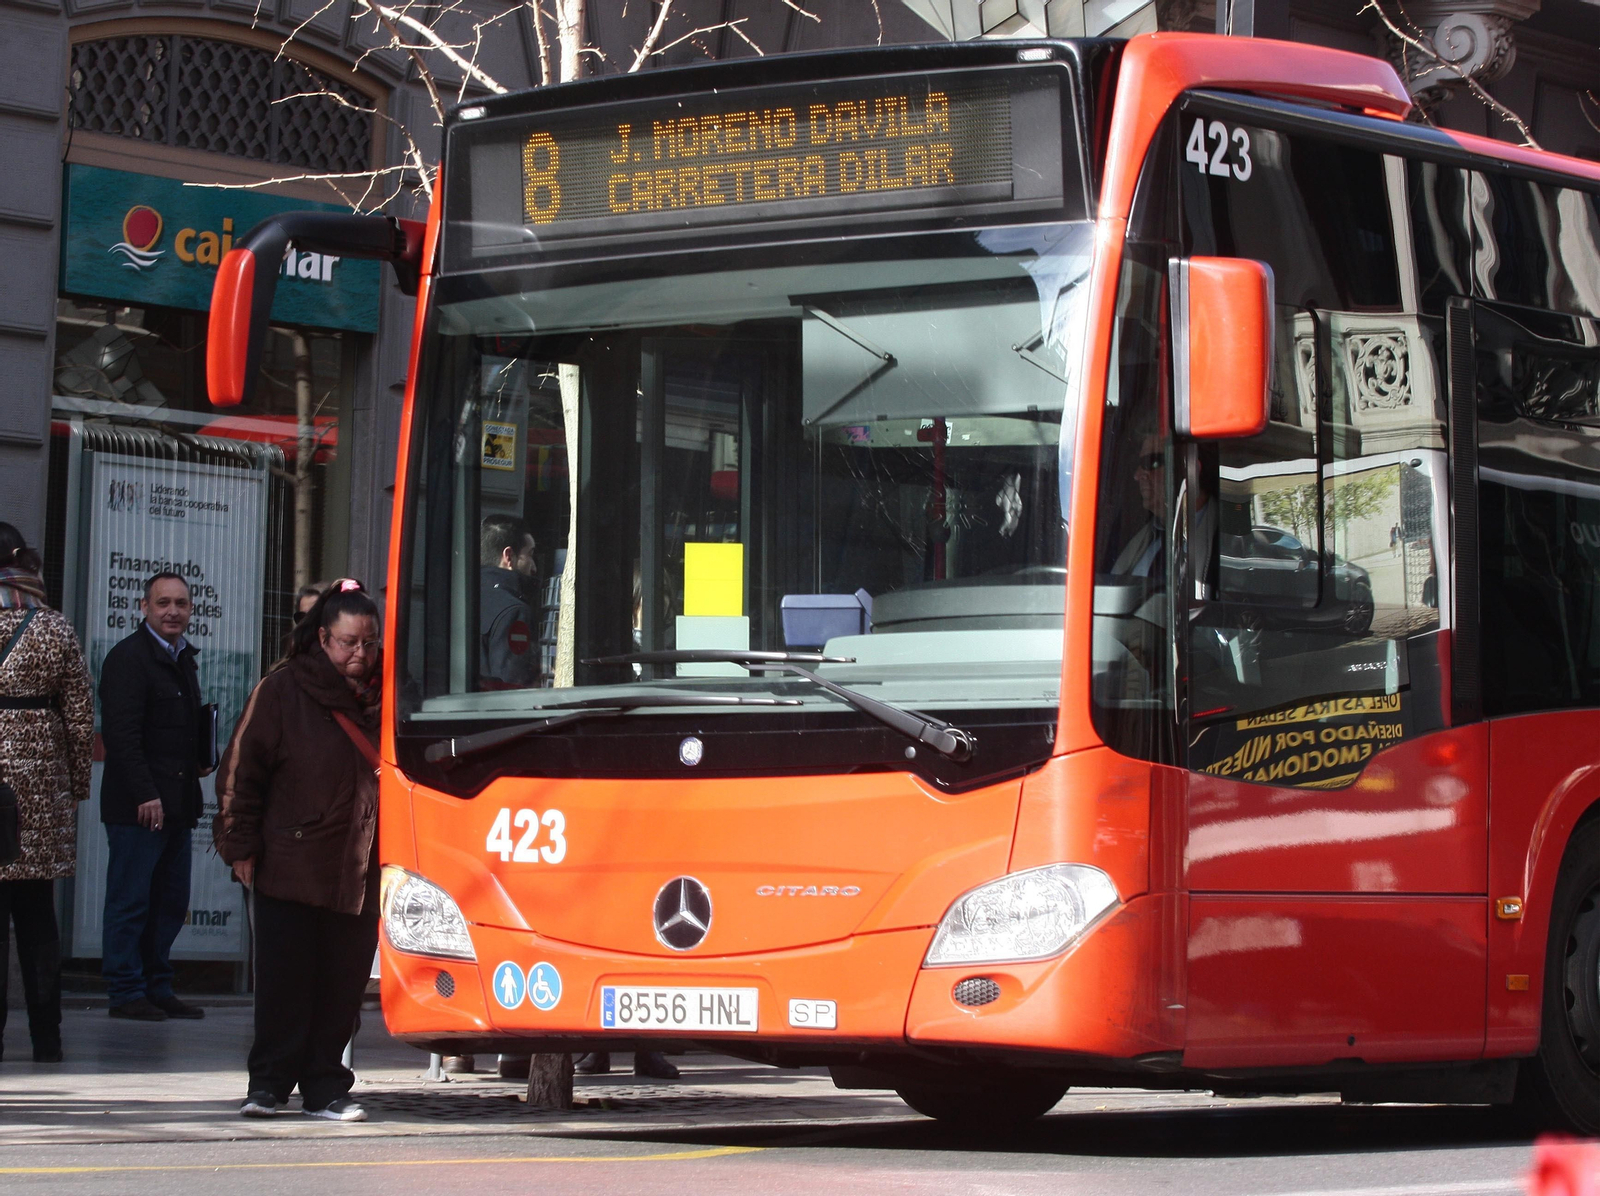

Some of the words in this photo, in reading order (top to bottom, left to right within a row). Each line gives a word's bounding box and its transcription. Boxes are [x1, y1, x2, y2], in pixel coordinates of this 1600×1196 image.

[610, 124, 640, 163] J.
[653, 107, 796, 159] MORENO
[810, 92, 949, 144] DAVILA
[1186, 117, 1252, 182] 423
[524, 132, 560, 224] 8
[608, 155, 825, 213] CARRETERA
[839, 143, 954, 193] DILAR
[151, 483, 189, 497] Liderando
[149, 505, 161, 515] del
[163, 506, 186, 518] futuro
[158, 495, 183, 507] banca
[184, 500, 229, 512] cooperativa
[110, 552, 204, 581] Financiando,
[108, 591, 128, 610] las
[107, 611, 126, 629] de
[486, 807, 567, 865] 423
[756, 885, 861, 897] CITARO
[618, 991, 687, 1024] 8556
[699, 993, 751, 1026] HNL
[793, 1003, 831, 1025] SP
